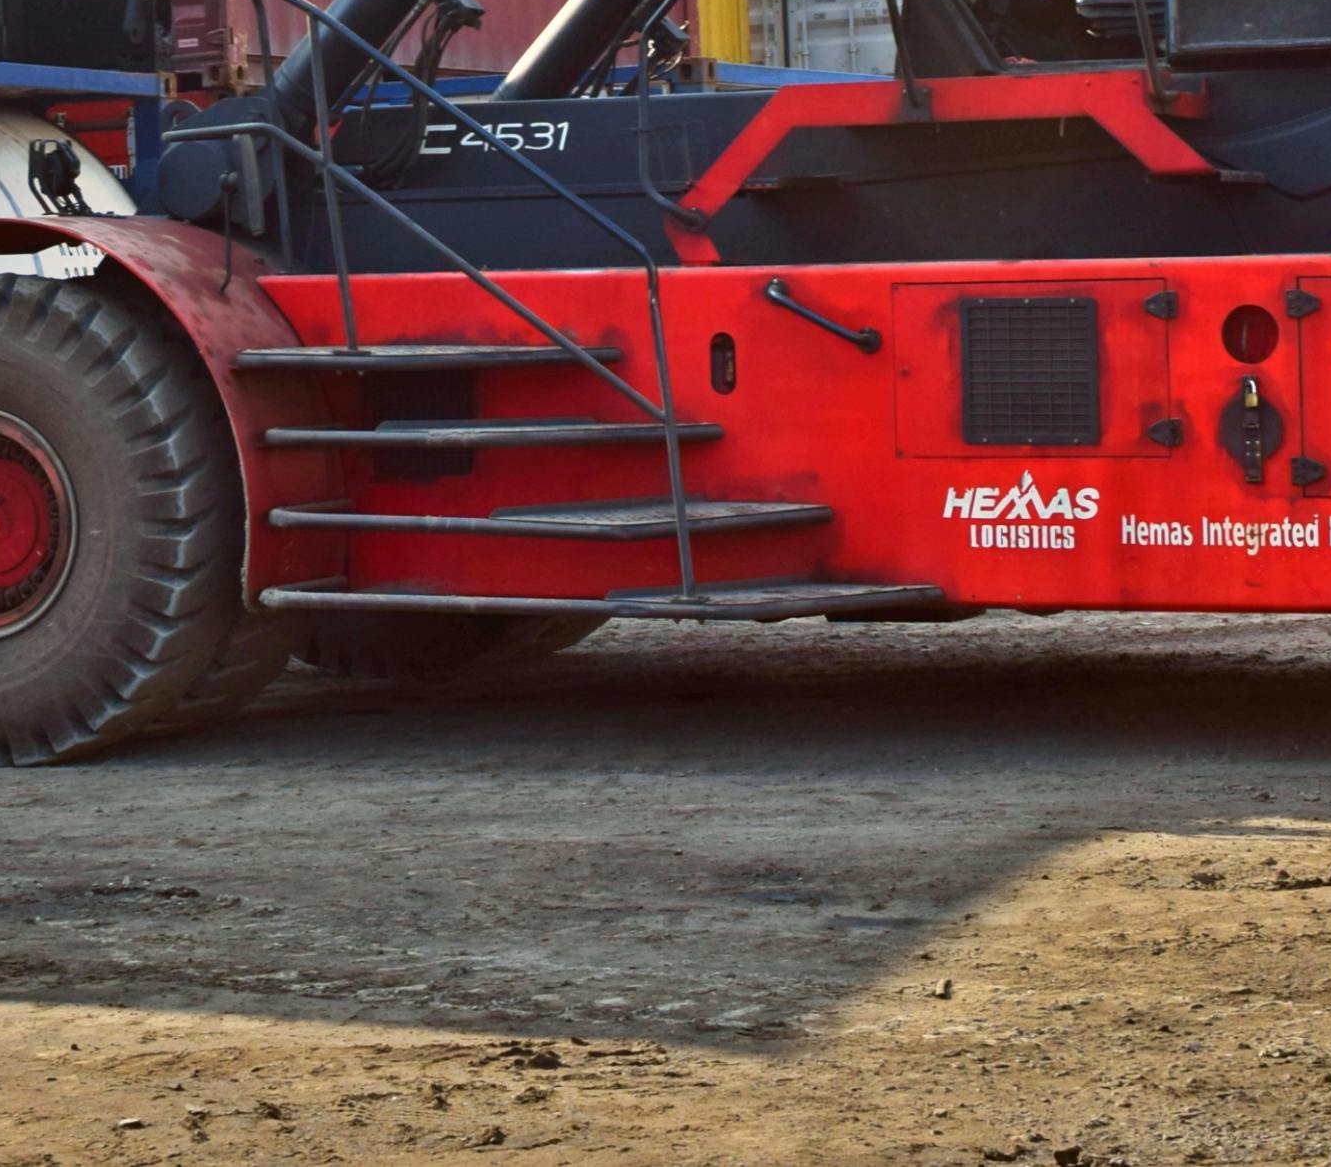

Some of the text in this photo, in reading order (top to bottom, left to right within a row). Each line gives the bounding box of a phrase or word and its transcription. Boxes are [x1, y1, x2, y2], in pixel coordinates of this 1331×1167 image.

[943, 484, 1100, 520] HEMAS
[970, 525, 1075, 549] LOGISTICS
[1121, 514, 1193, 545] Hemas
[1202, 516, 1319, 556] Integrated
